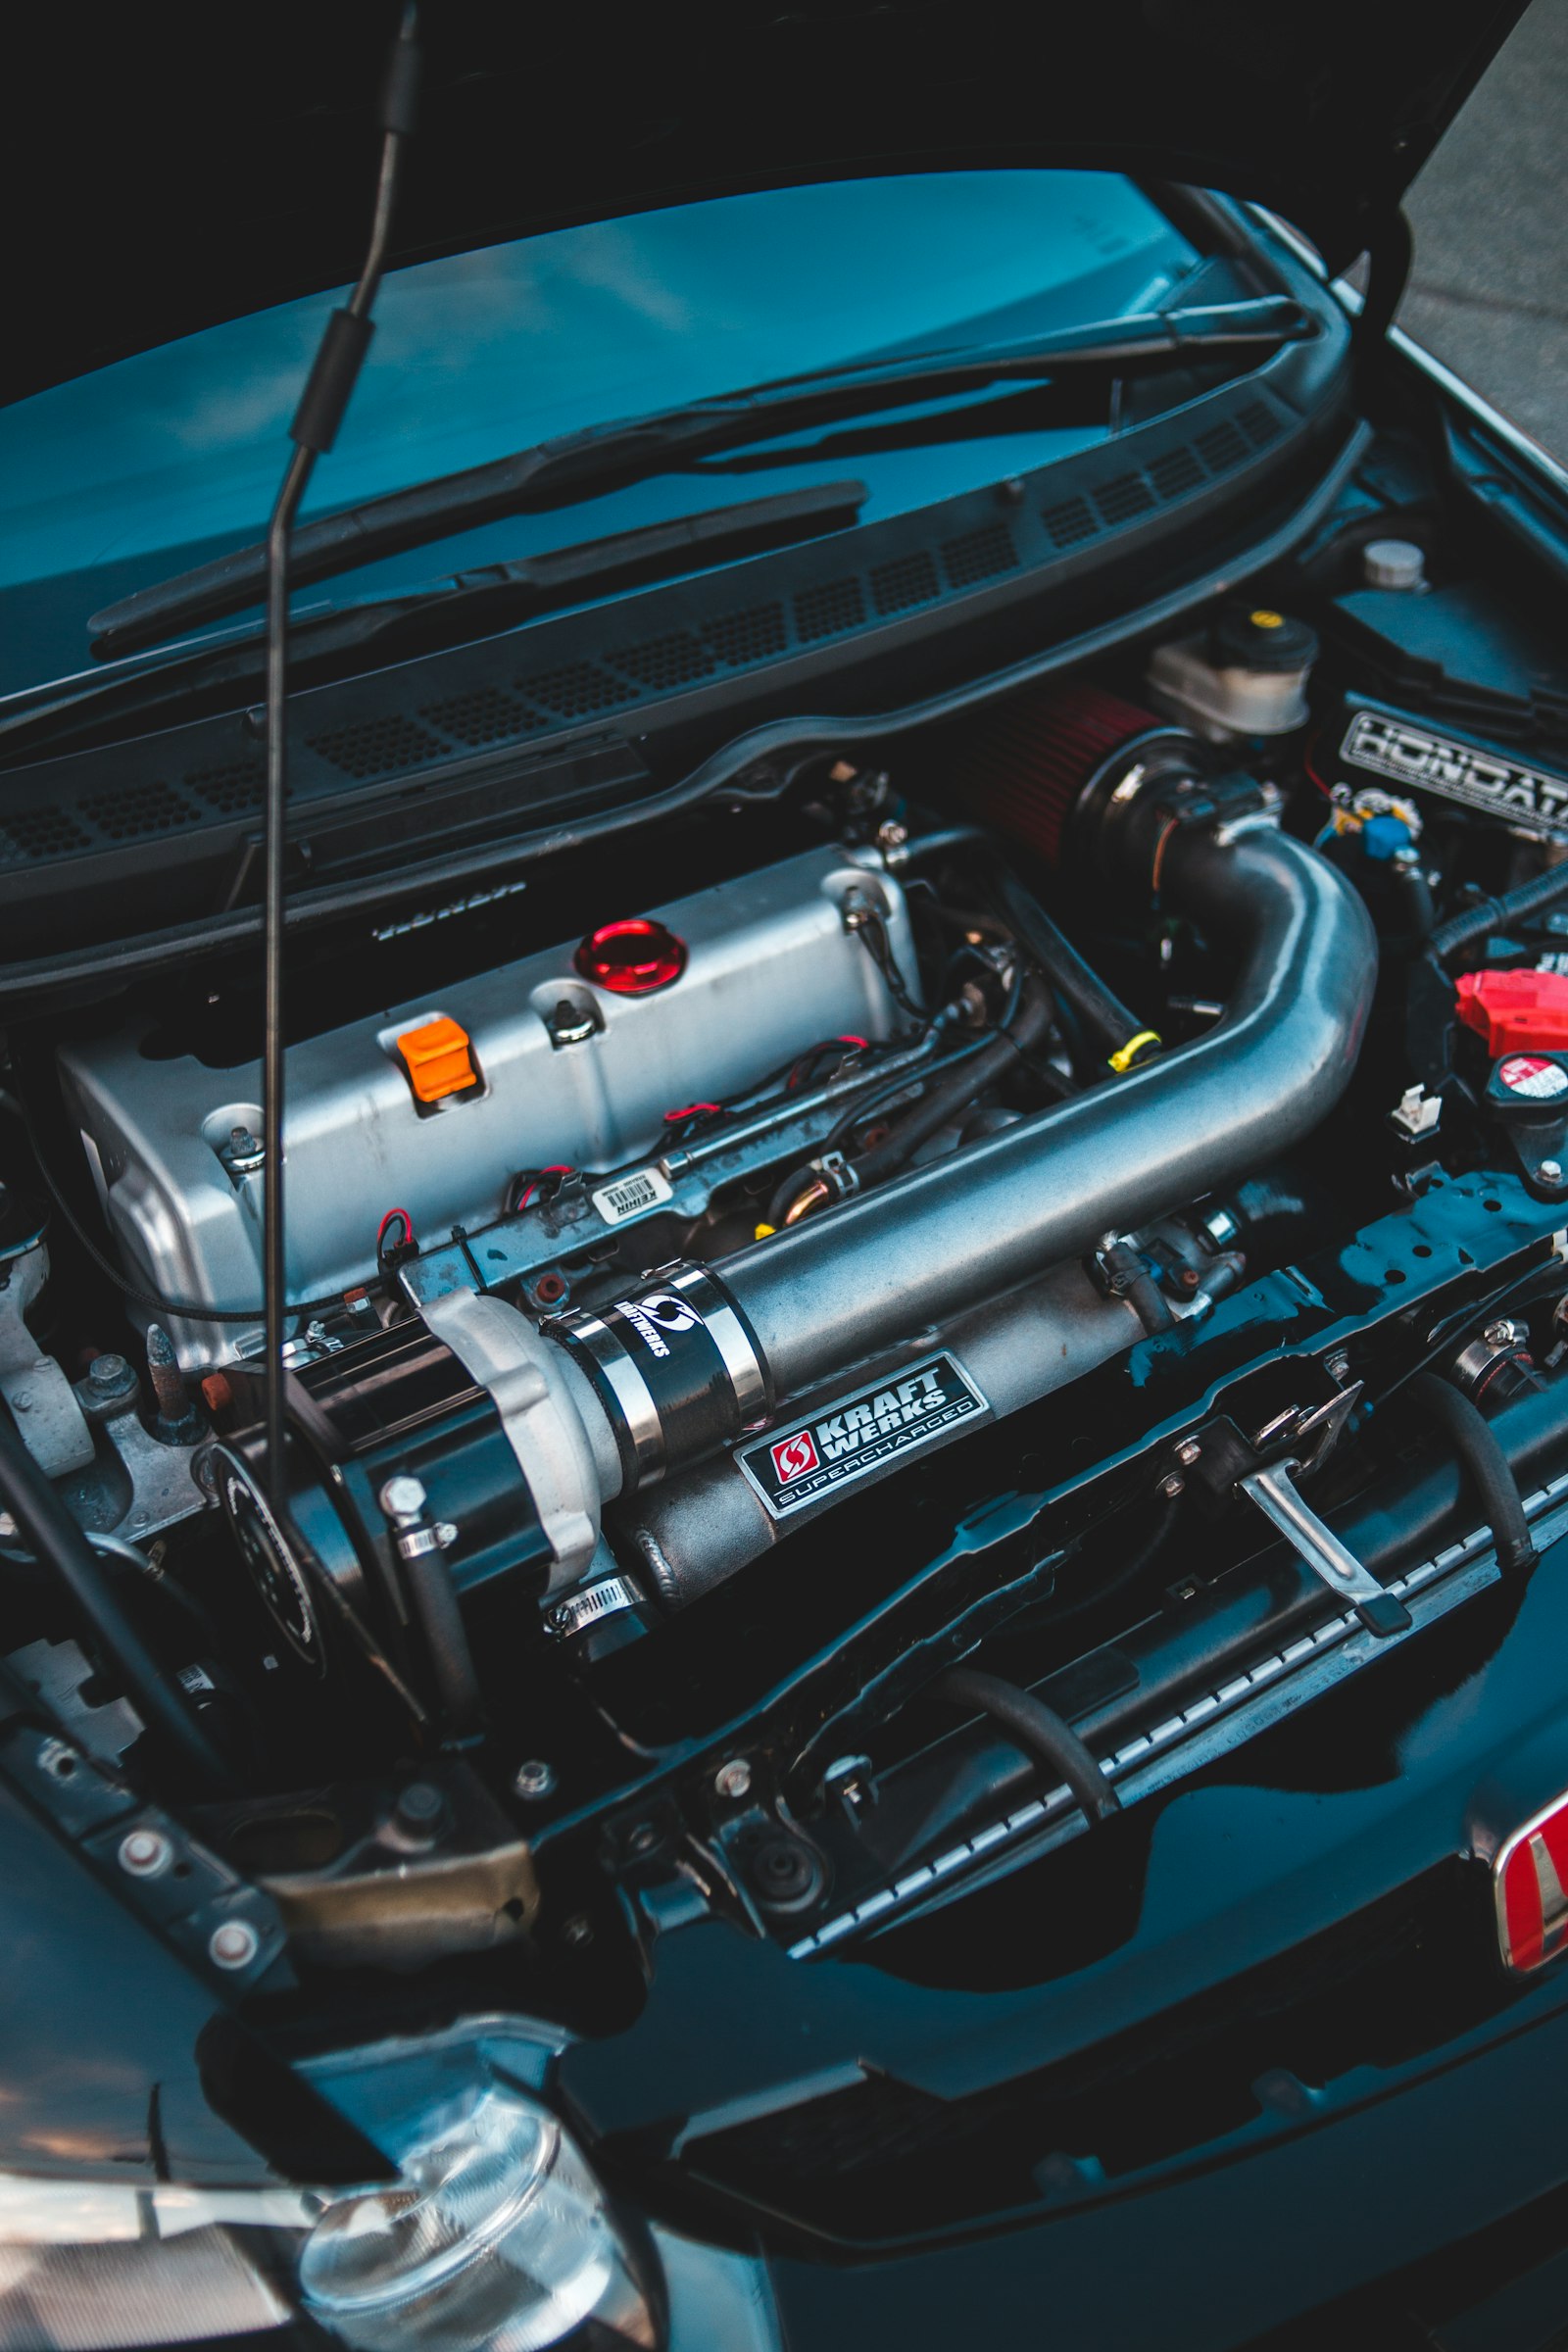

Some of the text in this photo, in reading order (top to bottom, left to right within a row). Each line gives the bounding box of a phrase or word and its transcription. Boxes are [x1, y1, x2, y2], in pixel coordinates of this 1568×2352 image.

[617, 1190, 658, 1215] KEIHIN
[613, 1300, 670, 1358] KRAFTWERKS
[815, 1366, 940, 1446] KRAFT
[821, 1389, 948, 1462] WERKS
[778, 1400, 974, 1506] SUPERCHARGED
